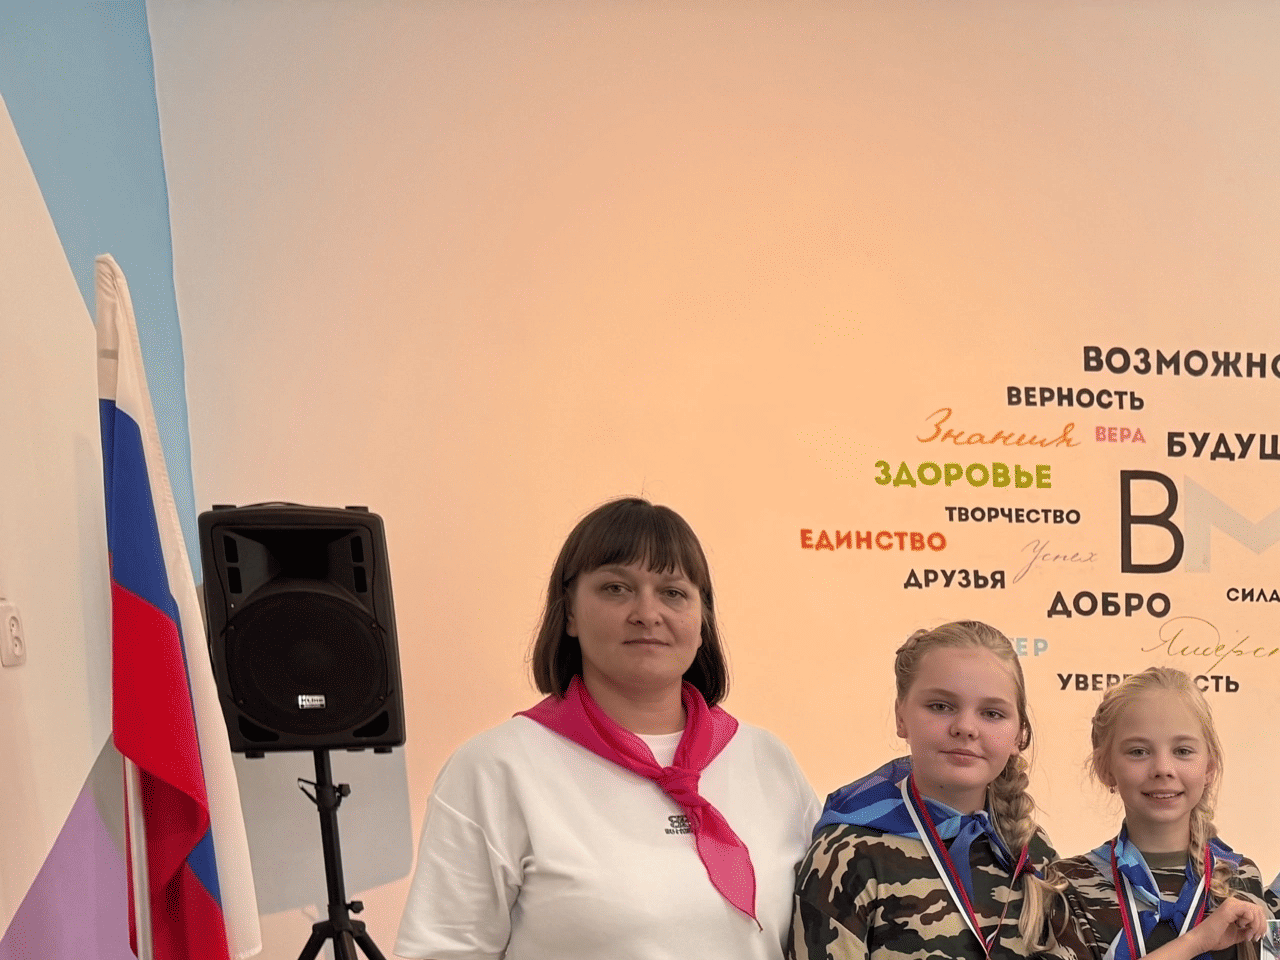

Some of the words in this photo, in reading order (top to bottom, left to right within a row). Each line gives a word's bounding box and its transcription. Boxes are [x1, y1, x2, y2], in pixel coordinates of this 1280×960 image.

[1007, 386, 1144, 410] ВЕРНОСТЬ
[916, 407, 1082, 448] Знания
[1095, 426, 1147, 444] ВЕРА
[874, 460, 1052, 489] ЗДОРОВЬЕ
[945, 506, 1081, 525] ТВОРЧЕСТВО
[800, 528, 947, 552] ЕДИНСТВО
[1012, 539, 1099, 585] Успех
[904, 569, 1006, 590] ДРУЗЬЯ
[1047, 591, 1171, 618] ДОБРО
